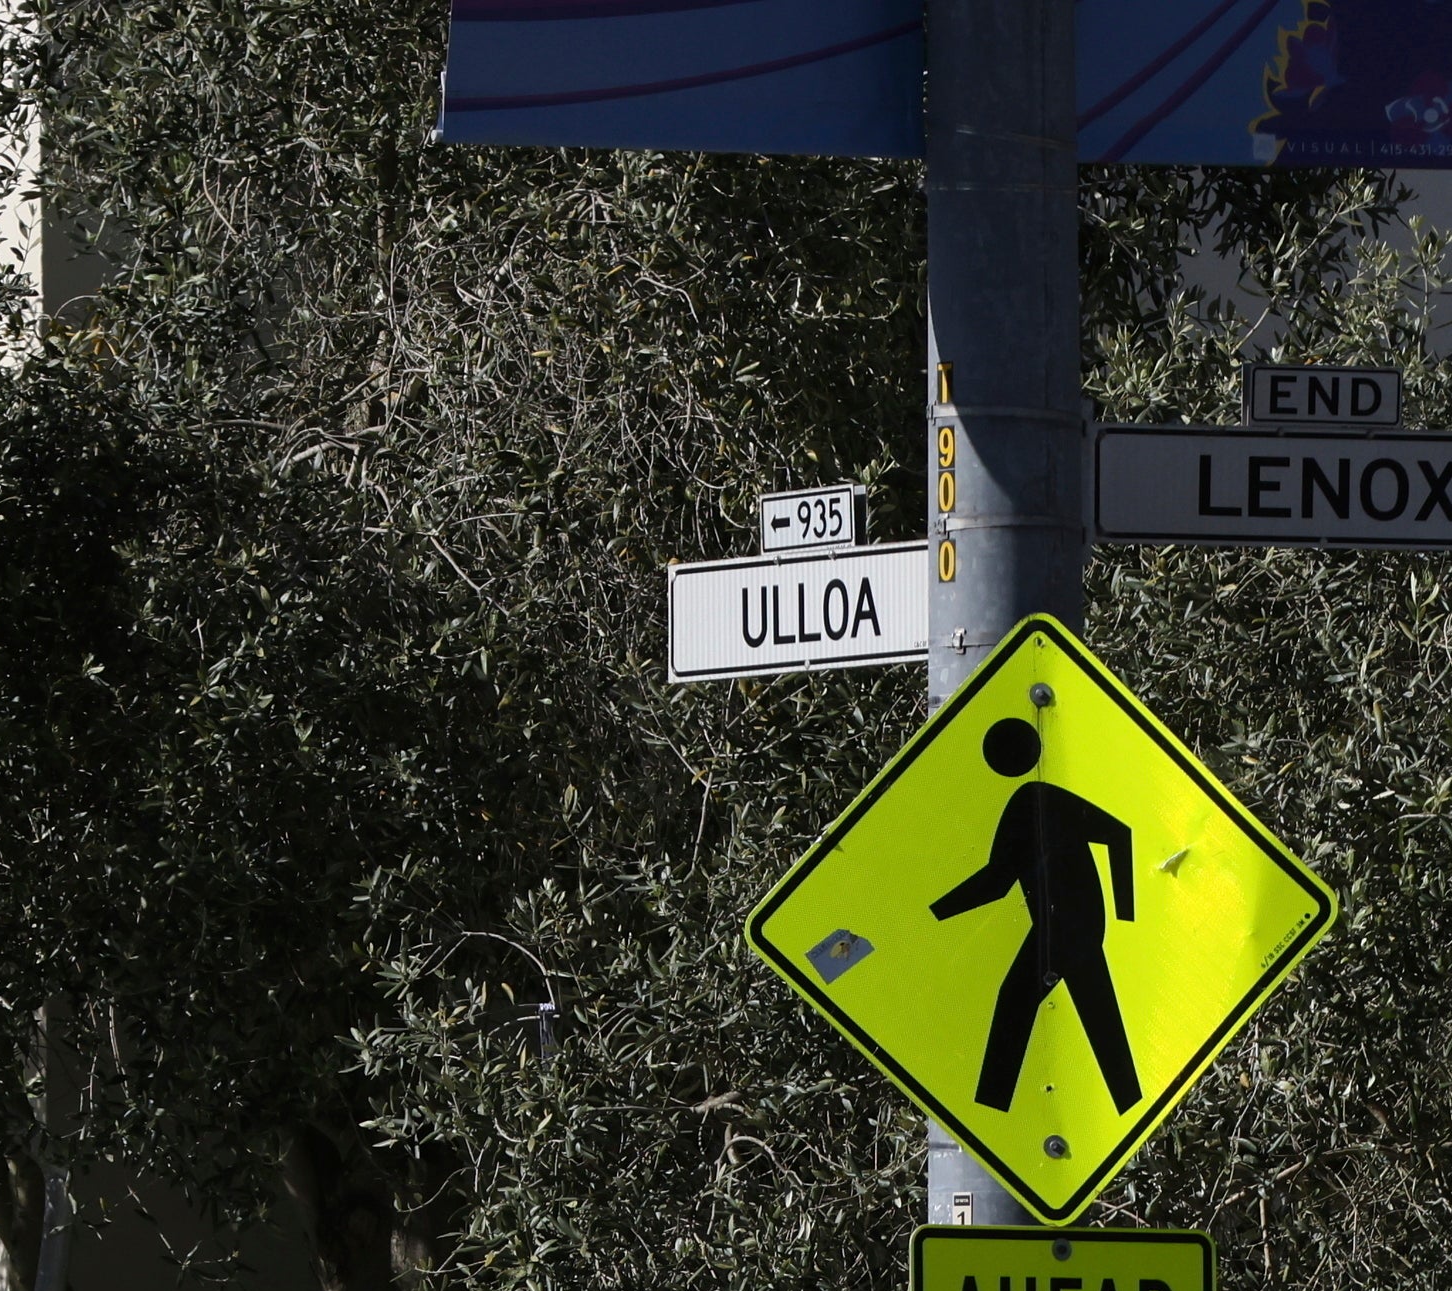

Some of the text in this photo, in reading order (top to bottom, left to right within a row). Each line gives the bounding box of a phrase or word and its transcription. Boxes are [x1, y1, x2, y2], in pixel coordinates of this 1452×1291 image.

[1286, 141, 1363, 154] VISUAL
[1269, 375, 1383, 418] END
[797, 497, 843, 540] 935
[742, 576, 881, 648] ULLOA
